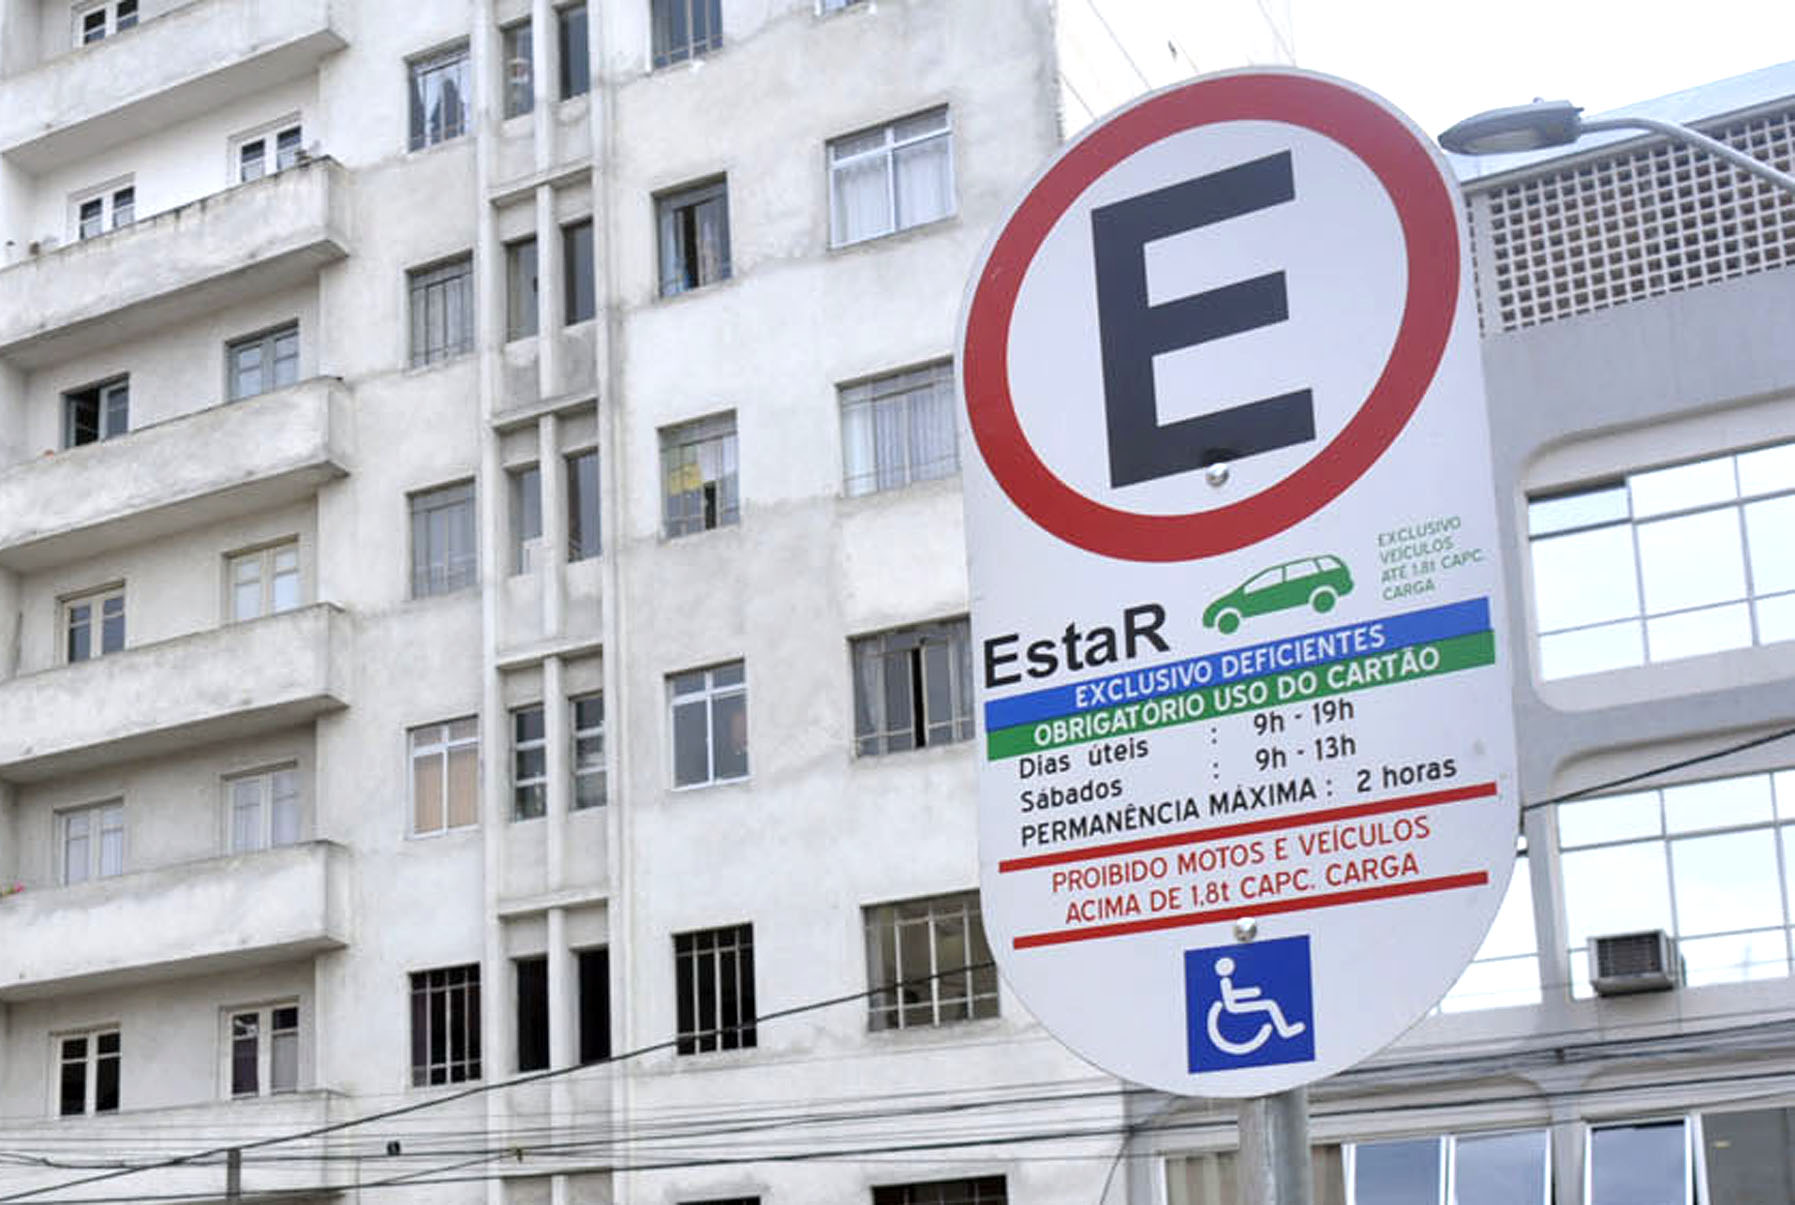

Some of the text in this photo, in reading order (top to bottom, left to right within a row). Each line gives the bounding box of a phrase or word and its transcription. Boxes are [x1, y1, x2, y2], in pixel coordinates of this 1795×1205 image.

[1092, 149, 1316, 489] E
[1378, 516, 1461, 547] EXCLUSIVO
[1383, 578, 1435, 600] CARGA
[984, 603, 1170, 688] EstaR
[1076, 624, 1386, 708] EXCLUSIVO DEFICIENTES
[1034, 646, 1440, 747] OBRIGATÓRIO USO DO CARTÃO
[1019, 754, 1070, 779] Dias
[1088, 737, 1149, 767] úteis
[1254, 711, 1285, 736] 9h
[1313, 697, 1354, 726] 19h
[1020, 778, 1123, 813] Sábados
[1255, 747, 1287, 771] 9h
[1315, 734, 1356, 761] 13h
[1021, 796, 1200, 848] PERMANÊNCIA
[1209, 776, 1317, 817] MÁXIMA
[1357, 769, 1372, 793] 2
[1383, 758, 1457, 789] horas
[1052, 815, 1431, 893] PROIBIDO MOTOS E VEÍCULOS
[1066, 894, 1141, 925] ACIMA
[1151, 887, 1182, 912] DE
[1240, 868, 1316, 899] CAPC.
[1326, 852, 1419, 887] CARGA
